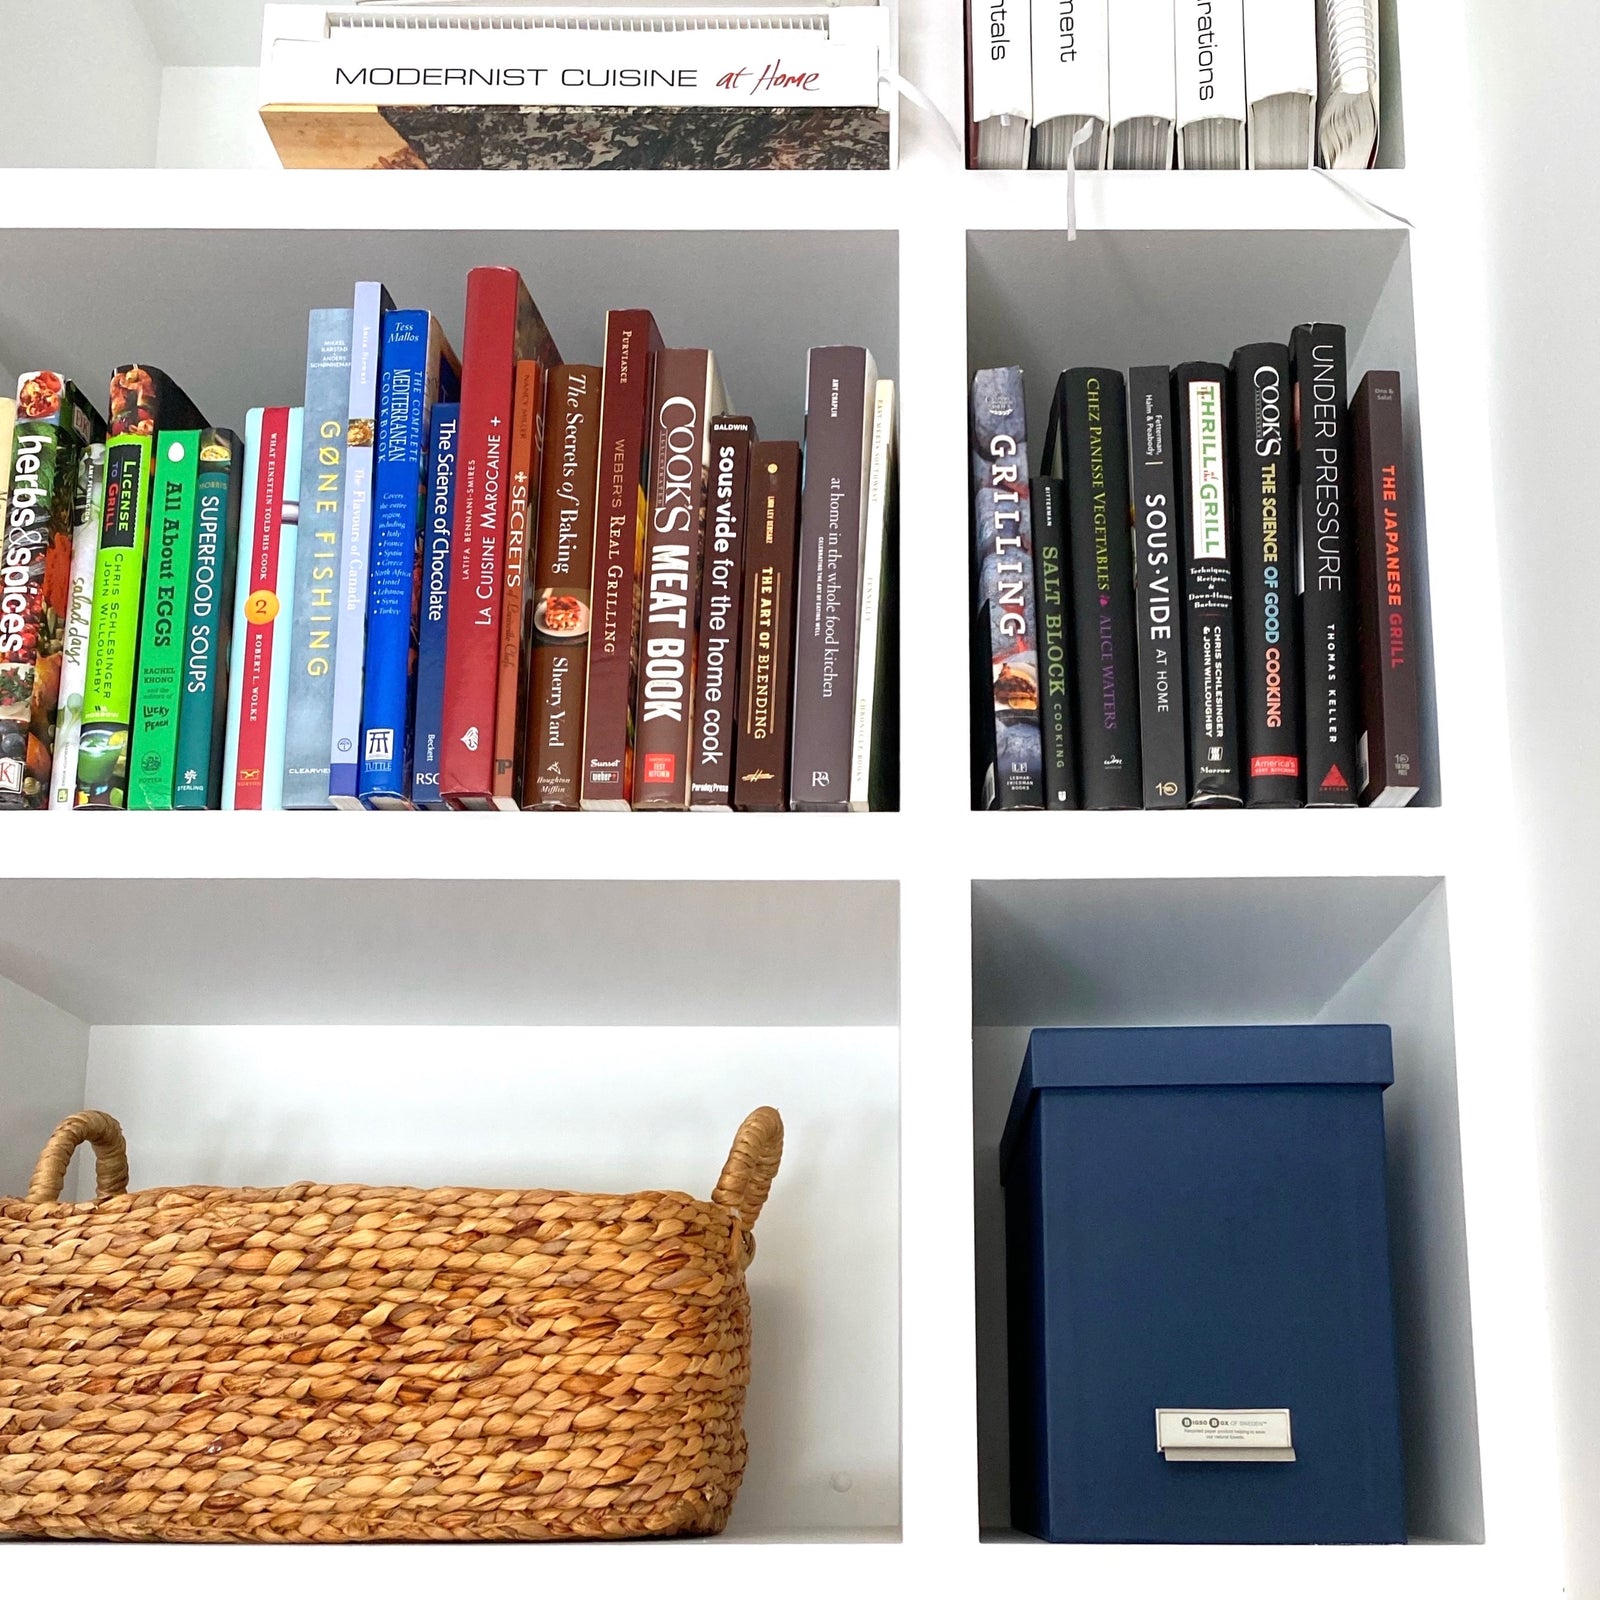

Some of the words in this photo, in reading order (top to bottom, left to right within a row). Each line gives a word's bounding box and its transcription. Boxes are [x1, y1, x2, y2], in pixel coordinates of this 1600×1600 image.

[1197, 0, 1218, 101] rations
[334, 65, 548, 88] MODERNIST
[561, 66, 698, 88] CUISINE
[715, 67, 750, 91] at
[750, 58, 820, 95] Home
[388, 333, 419, 343] Mallos
[395, 322, 414, 331] Tess
[619, 330, 633, 384] PURVIANCE
[412, 370, 422, 394] THE
[521, 374, 530, 406] NANCY
[566, 373, 587, 407] The
[830, 393, 839, 417] CHAPLIN
[831, 378, 840, 391] AMY
[1086, 378, 1101, 422] CHEZ
[1145, 394, 1154, 414] Halm
[1312, 343, 1336, 439] UNDER
[377, 372, 391, 464] COOKBOOK
[388, 369, 411, 463] MEDITERRANEAN
[408, 398, 421, 463] COMPLETE
[438, 418, 457, 450] The
[520, 409, 529, 439] MILLER
[713, 423, 749, 431] BALDWIN
[1196, 386, 1217, 469] THRILL
[1252, 365, 1281, 458] COOK'S
[267, 433, 277, 459] WHAT
[561, 412, 585, 477] Secrets
[1089, 426, 1105, 488] PANISSE
[1146, 423, 1154, 455] Peabody
[111, 461, 118, 477] TO
[265, 460, 274, 506] EINSTEIN
[316, 420, 340, 513] GØNE
[433, 453, 454, 515] Science
[479, 435, 501, 529] MAROCAINE
[611, 439, 626, 508] WEBER'S
[653, 395, 696, 533] COOK'S
[717, 446, 738, 498] sous
[830, 477, 842, 489] at
[1260, 463, 1275, 495] THE
[1382, 464, 1396, 502] THE
[85, 480, 93, 521] PENNINGTON
[105, 483, 118, 532] GRILL
[118, 460, 136, 532] LICENSE
[165, 481, 182, 511] All
[352, 490, 366, 542] Flavours
[463, 459, 476, 542] BENNANI-SMIRES
[557, 482, 582, 507] of
[828, 493, 843, 529] home
[1045, 486, 1053, 527] BITTERMAN
[262, 507, 271, 533] TOLD
[432, 517, 450, 536] of
[506, 485, 527, 588] SECRETS
[551, 508, 579, 574] Baking
[609, 515, 626, 561] REAL
[714, 500, 737, 553] vide
[828, 532, 841, 545] in
[989, 434, 1027, 637] GRILLING
[1092, 492, 1111, 591] VEGETABLES
[1200, 484, 1219, 553] GRILL
[1262, 497, 1277, 563] SCIENCE
[1314, 447, 1340, 592] PRESSURE
[159, 518, 180, 581] About
[193, 495, 219, 616] SUPERFOOD
[261, 534, 270, 551] HIS
[350, 545, 361, 557] of
[461, 548, 471, 581] LATIFA
[827, 549, 842, 569] the
[1384, 507, 1401, 606] JAPANESE
[100, 560, 112, 599] JOHN
[109, 553, 124, 597] CHRIS
[259, 553, 268, 581] COOK
[347, 559, 363, 611] Canada
[428, 537, 449, 621] Chocolate
[477, 537, 497, 599] CUISINE
[650, 543, 691, 629] MEAT
[711, 559, 735, 591] for
[763, 567, 773, 595] THE
[1042, 546, 1061, 605] SALT
[1264, 566, 1277, 590] OF
[71, 578, 92, 624] salad
[154, 585, 173, 647] EGGS
[255, 599, 267, 614] 2
[307, 532, 336, 677] FISHING
[603, 565, 623, 654] GRILLING
[710, 595, 733, 631] the
[759, 598, 772, 630] ART
[825, 573, 840, 613] whole
[1188, 592, 1232, 600] Down-Home
[475, 607, 493, 627] LA
[823, 616, 840, 645] food
[1099, 614, 1114, 662] ALICE
[1203, 626, 1210, 635] &
[1264, 592, 1279, 644] GOOD
[65, 627, 87, 666] days
[93, 603, 109, 694] WILLOUGHBY
[103, 602, 120, 699] SCHLESINGER
[187, 624, 210, 693] SOUPS
[253, 634, 263, 672] ROBERT
[759, 632, 770, 650] OF
[1046, 614, 1065, 697] BLOCK
[1155, 649, 1168, 666] AT
[1203, 637, 1211, 666] JOHN
[1327, 624, 1336, 682] THOMAS
[1389, 613, 1404, 669] GRILL
[252, 676, 260, 684] L.
[546, 657, 569, 707] Sherry
[643, 639, 685, 724] BOOK
[705, 637, 730, 702] home
[822, 647, 838, 698] kitchen
[1156, 670, 1169, 713] HOME
[1266, 647, 1281, 728] COOKING
[249, 687, 260, 722] WOLKE
[753, 654, 770, 740] BLENDING
[1102, 665, 1117, 730] WATERS
[1204, 667, 1213, 737] WILLOUGHBY
[1215, 661, 1223, 737] SCHLESINGER
[1327, 689, 1337, 744] KELLER
[426, 734, 435, 761] Beckett
[548, 710, 566, 747] Yard
[700, 708, 724, 765] cook
[1053, 703, 1065, 769] COOKING
[365, 762, 392, 772] TUTTLE
[590, 759, 621, 768] Sunset
[1255, 760, 1295, 768] America's
